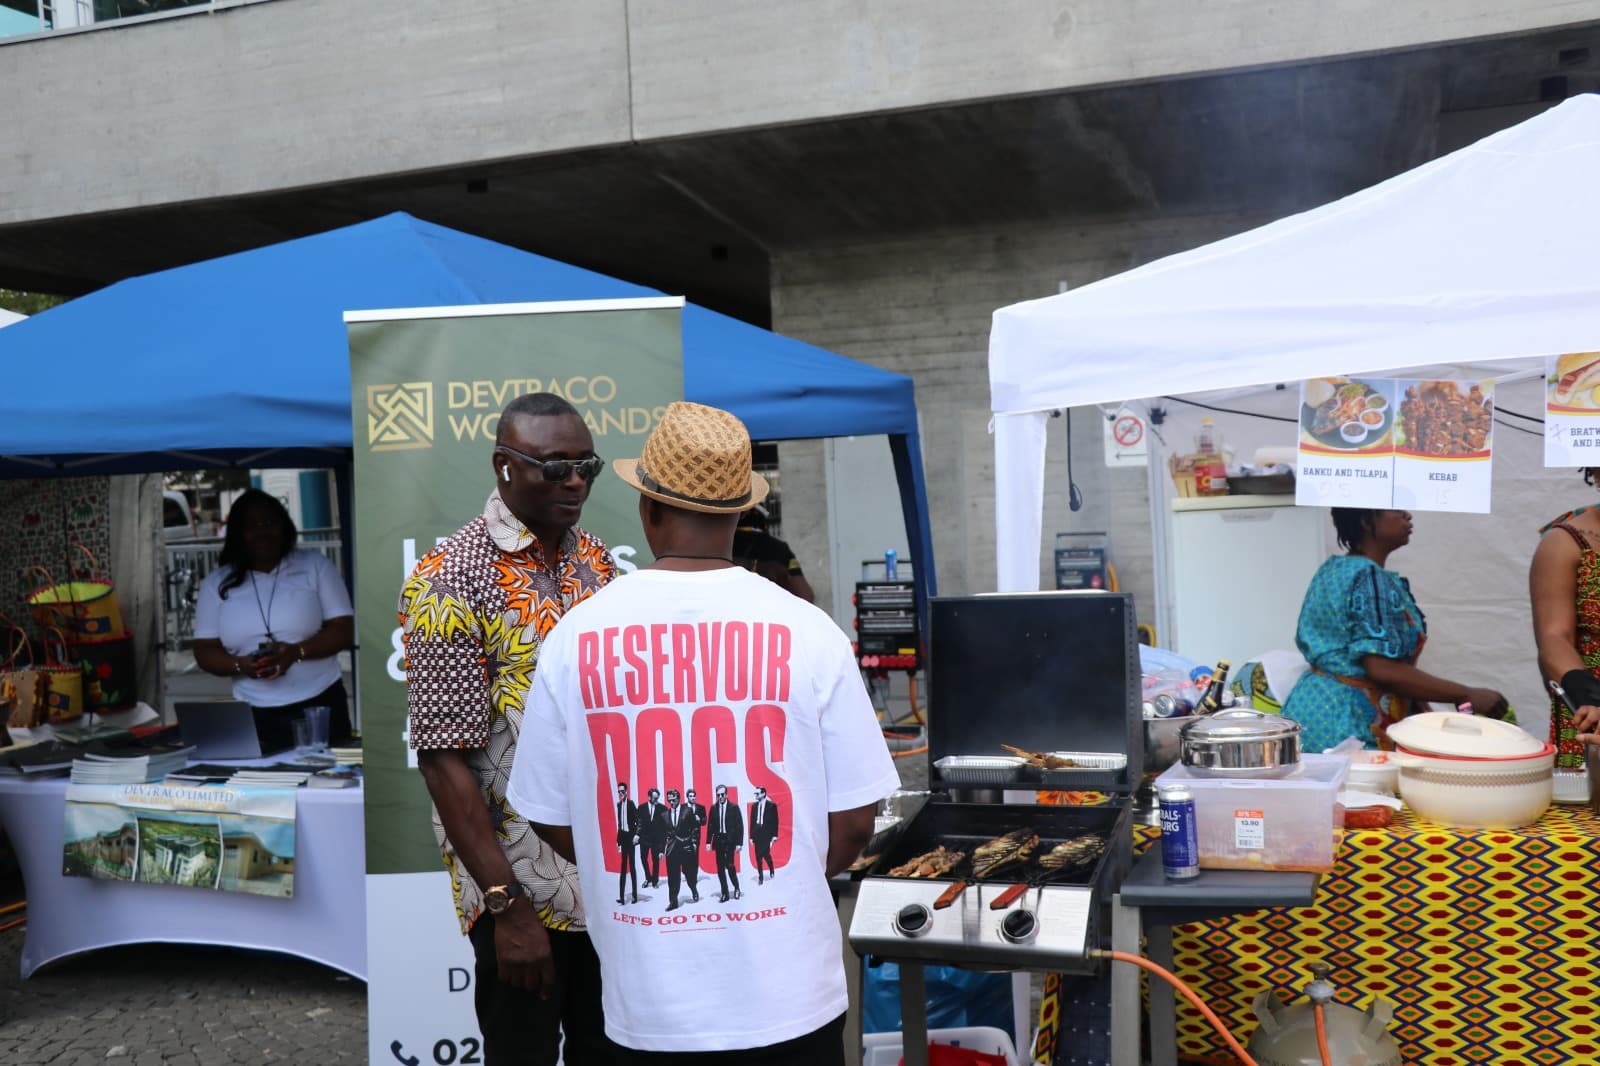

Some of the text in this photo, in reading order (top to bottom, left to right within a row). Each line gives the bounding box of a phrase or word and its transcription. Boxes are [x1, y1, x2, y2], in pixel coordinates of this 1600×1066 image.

[1573, 439, 1592, 447] AND
[1335, 468, 1352, 477] AND
[1355, 469, 1388, 479] TILAPIA
[1429, 472, 1457, 481] KEBAB
[578, 621, 791, 709] RESERVOIR
[586, 704, 793, 877] DOGS
[613, 906, 787, 926] LET'S GO TO WORK
